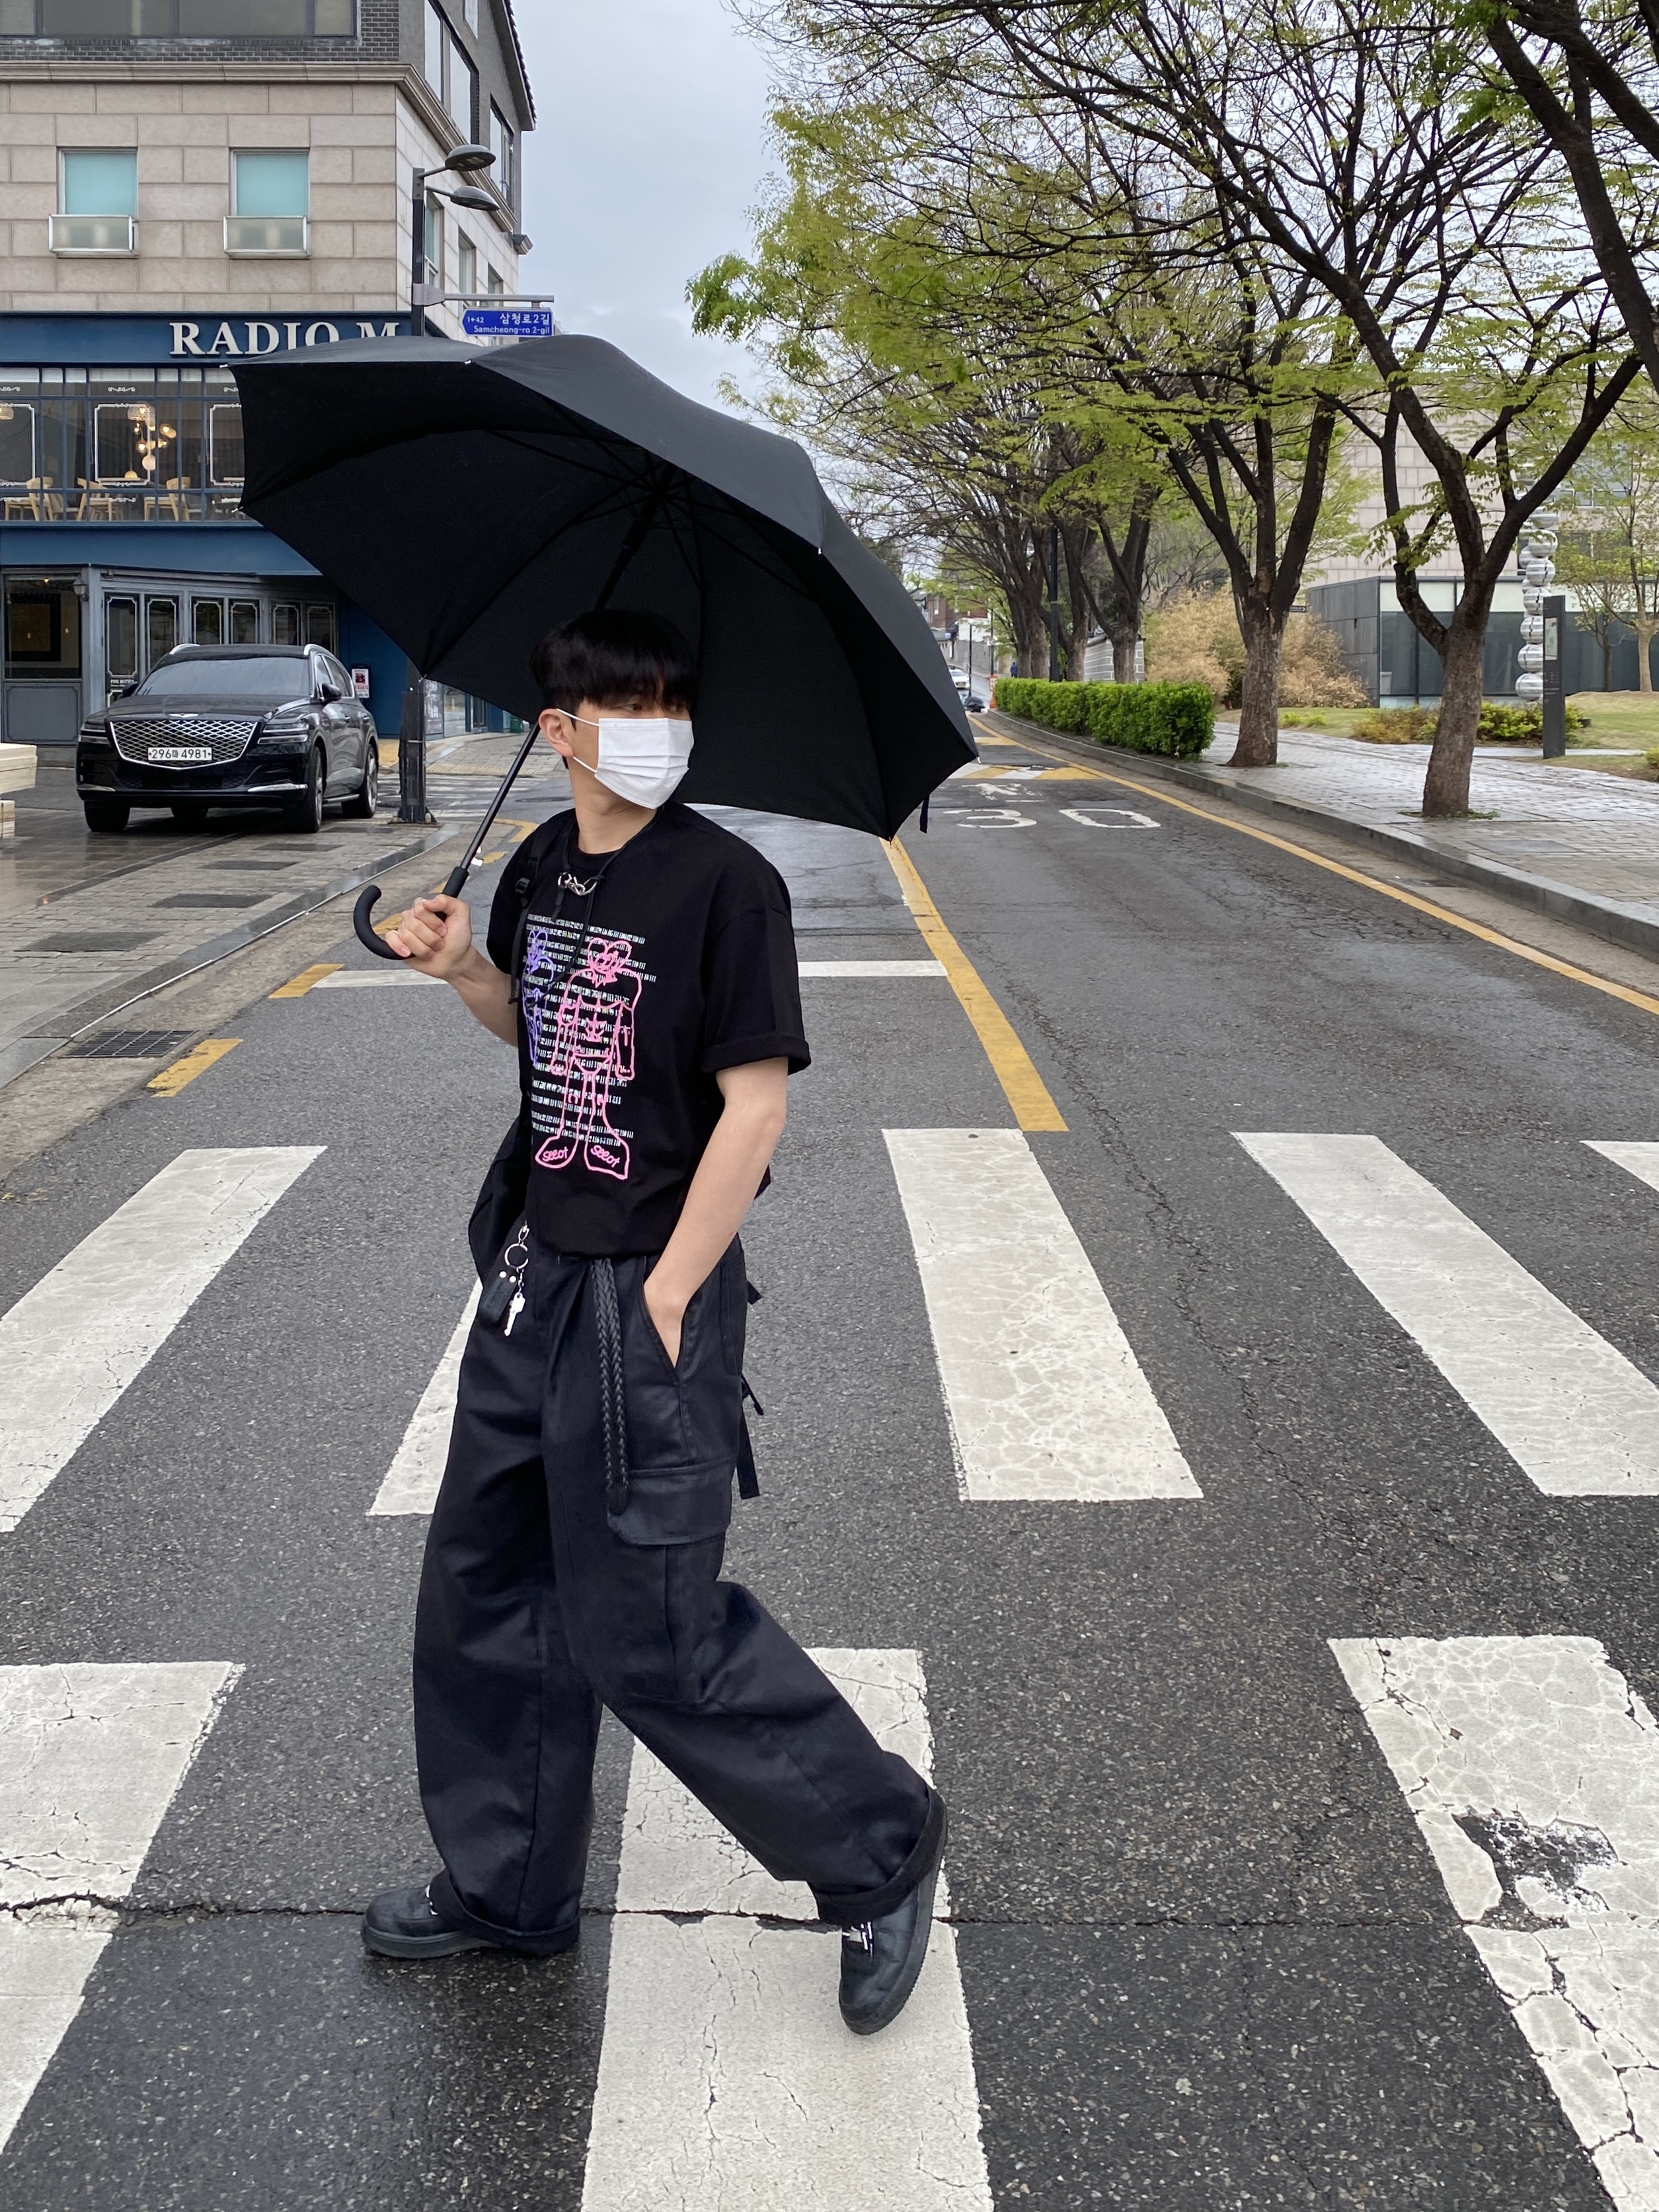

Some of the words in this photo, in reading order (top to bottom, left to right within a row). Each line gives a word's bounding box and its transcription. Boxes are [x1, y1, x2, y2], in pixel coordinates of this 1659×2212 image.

[500, 313, 550, 325] 삼청로2길
[473, 325, 530, 334] Samcheong-ro
[532, 326, 550, 334] 2-gil
[169, 321, 340, 355] RADIO
[181, 749, 206, 759] 4981
[943, 808, 1161, 829] 30
